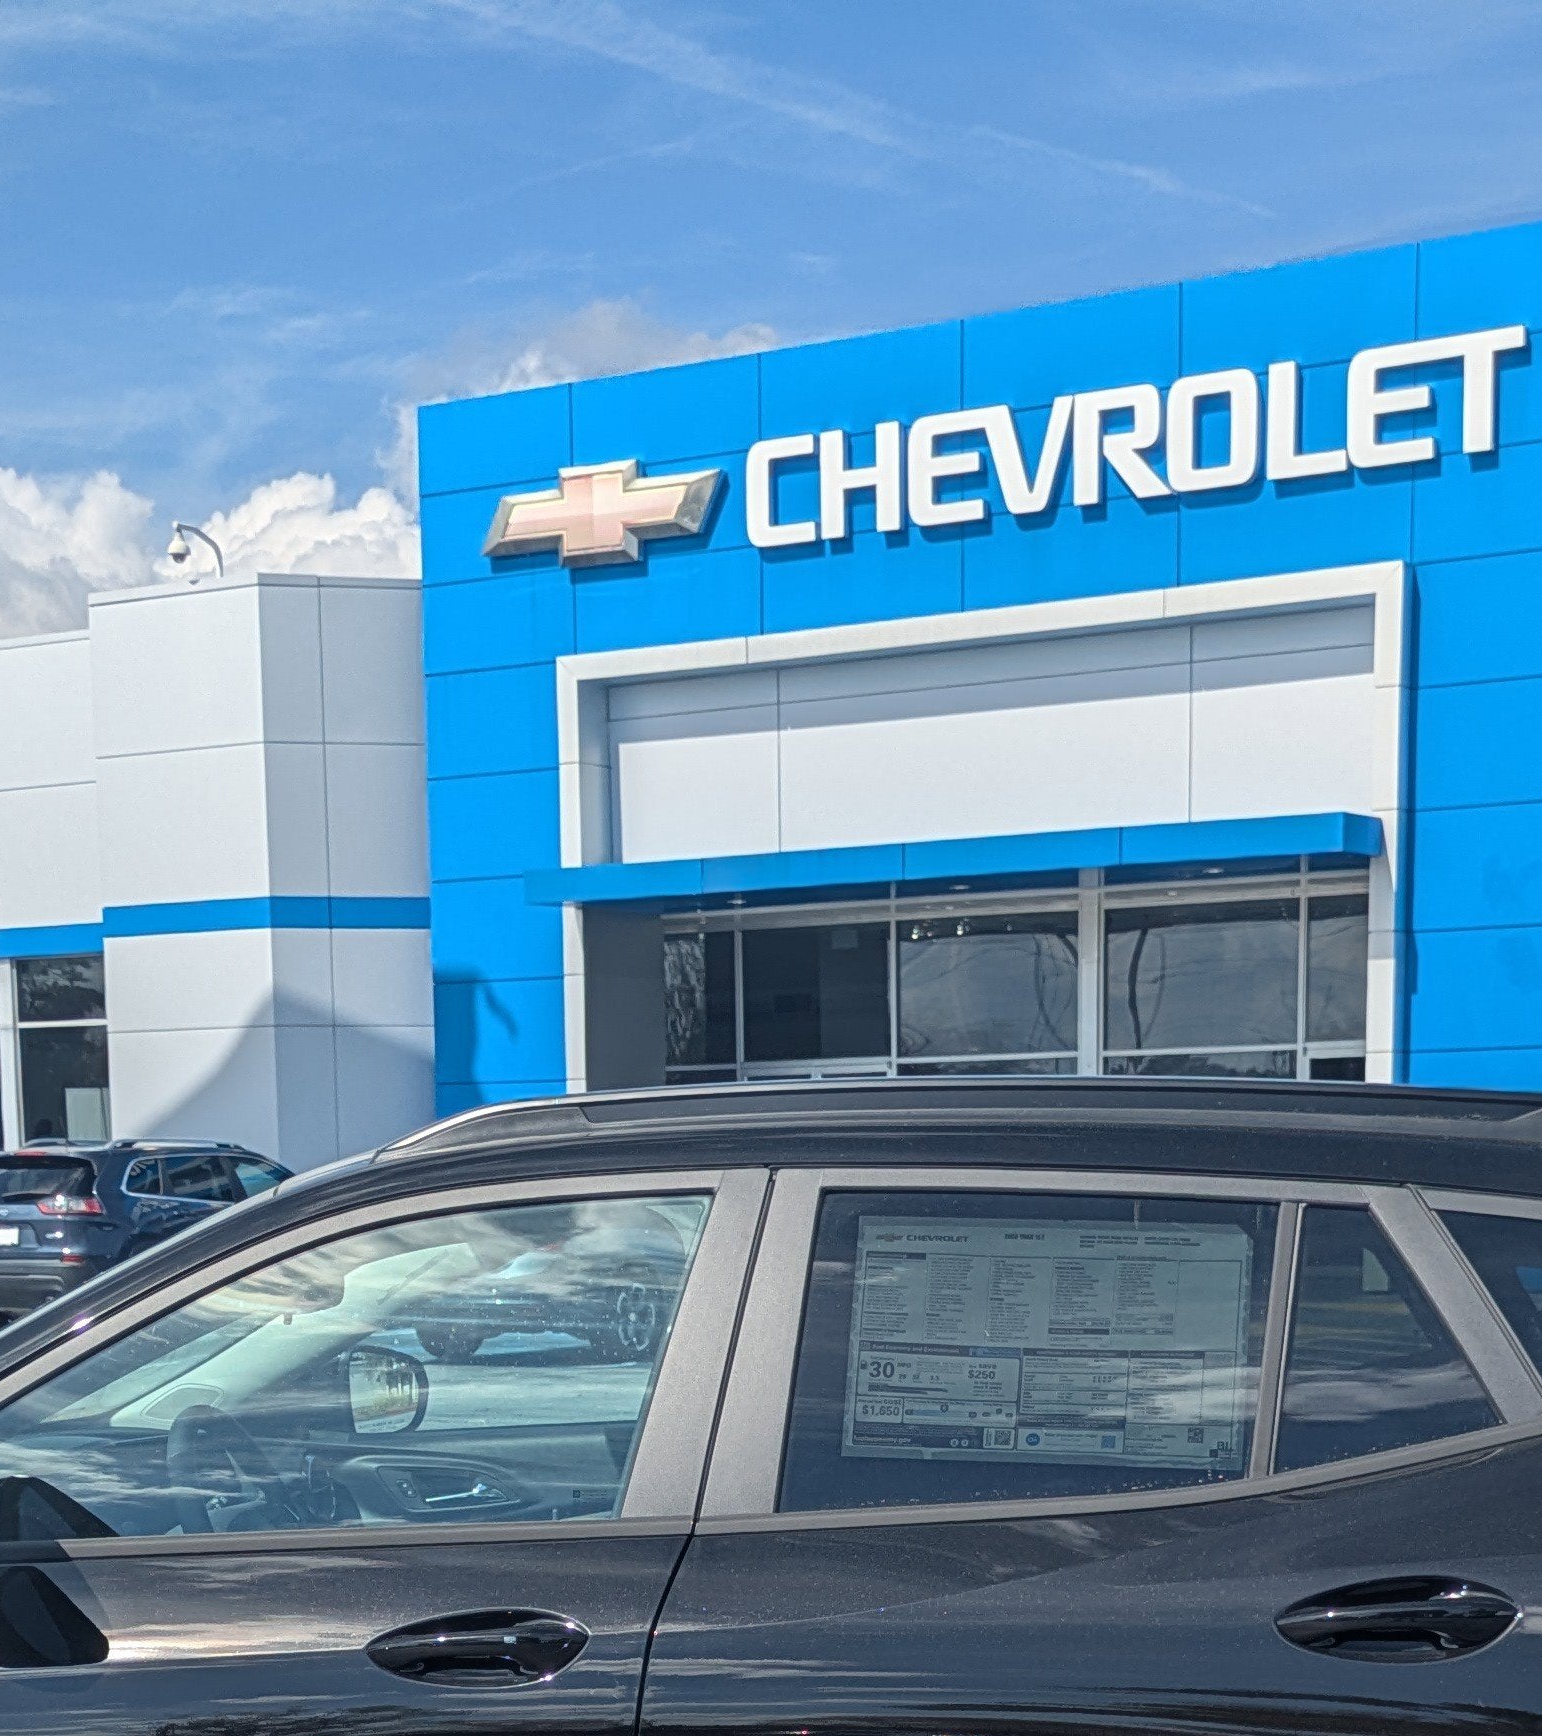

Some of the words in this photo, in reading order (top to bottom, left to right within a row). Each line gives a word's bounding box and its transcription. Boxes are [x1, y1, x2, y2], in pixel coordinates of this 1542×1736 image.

[745, 325, 1527, 549] CHEVROLET
[906, 1234, 970, 1243] CHEVROLET
[869, 1361, 895, 1379] 30
[967, 1370, 996, 1380] $250
[862, 1404, 900, 1416] $1,650
